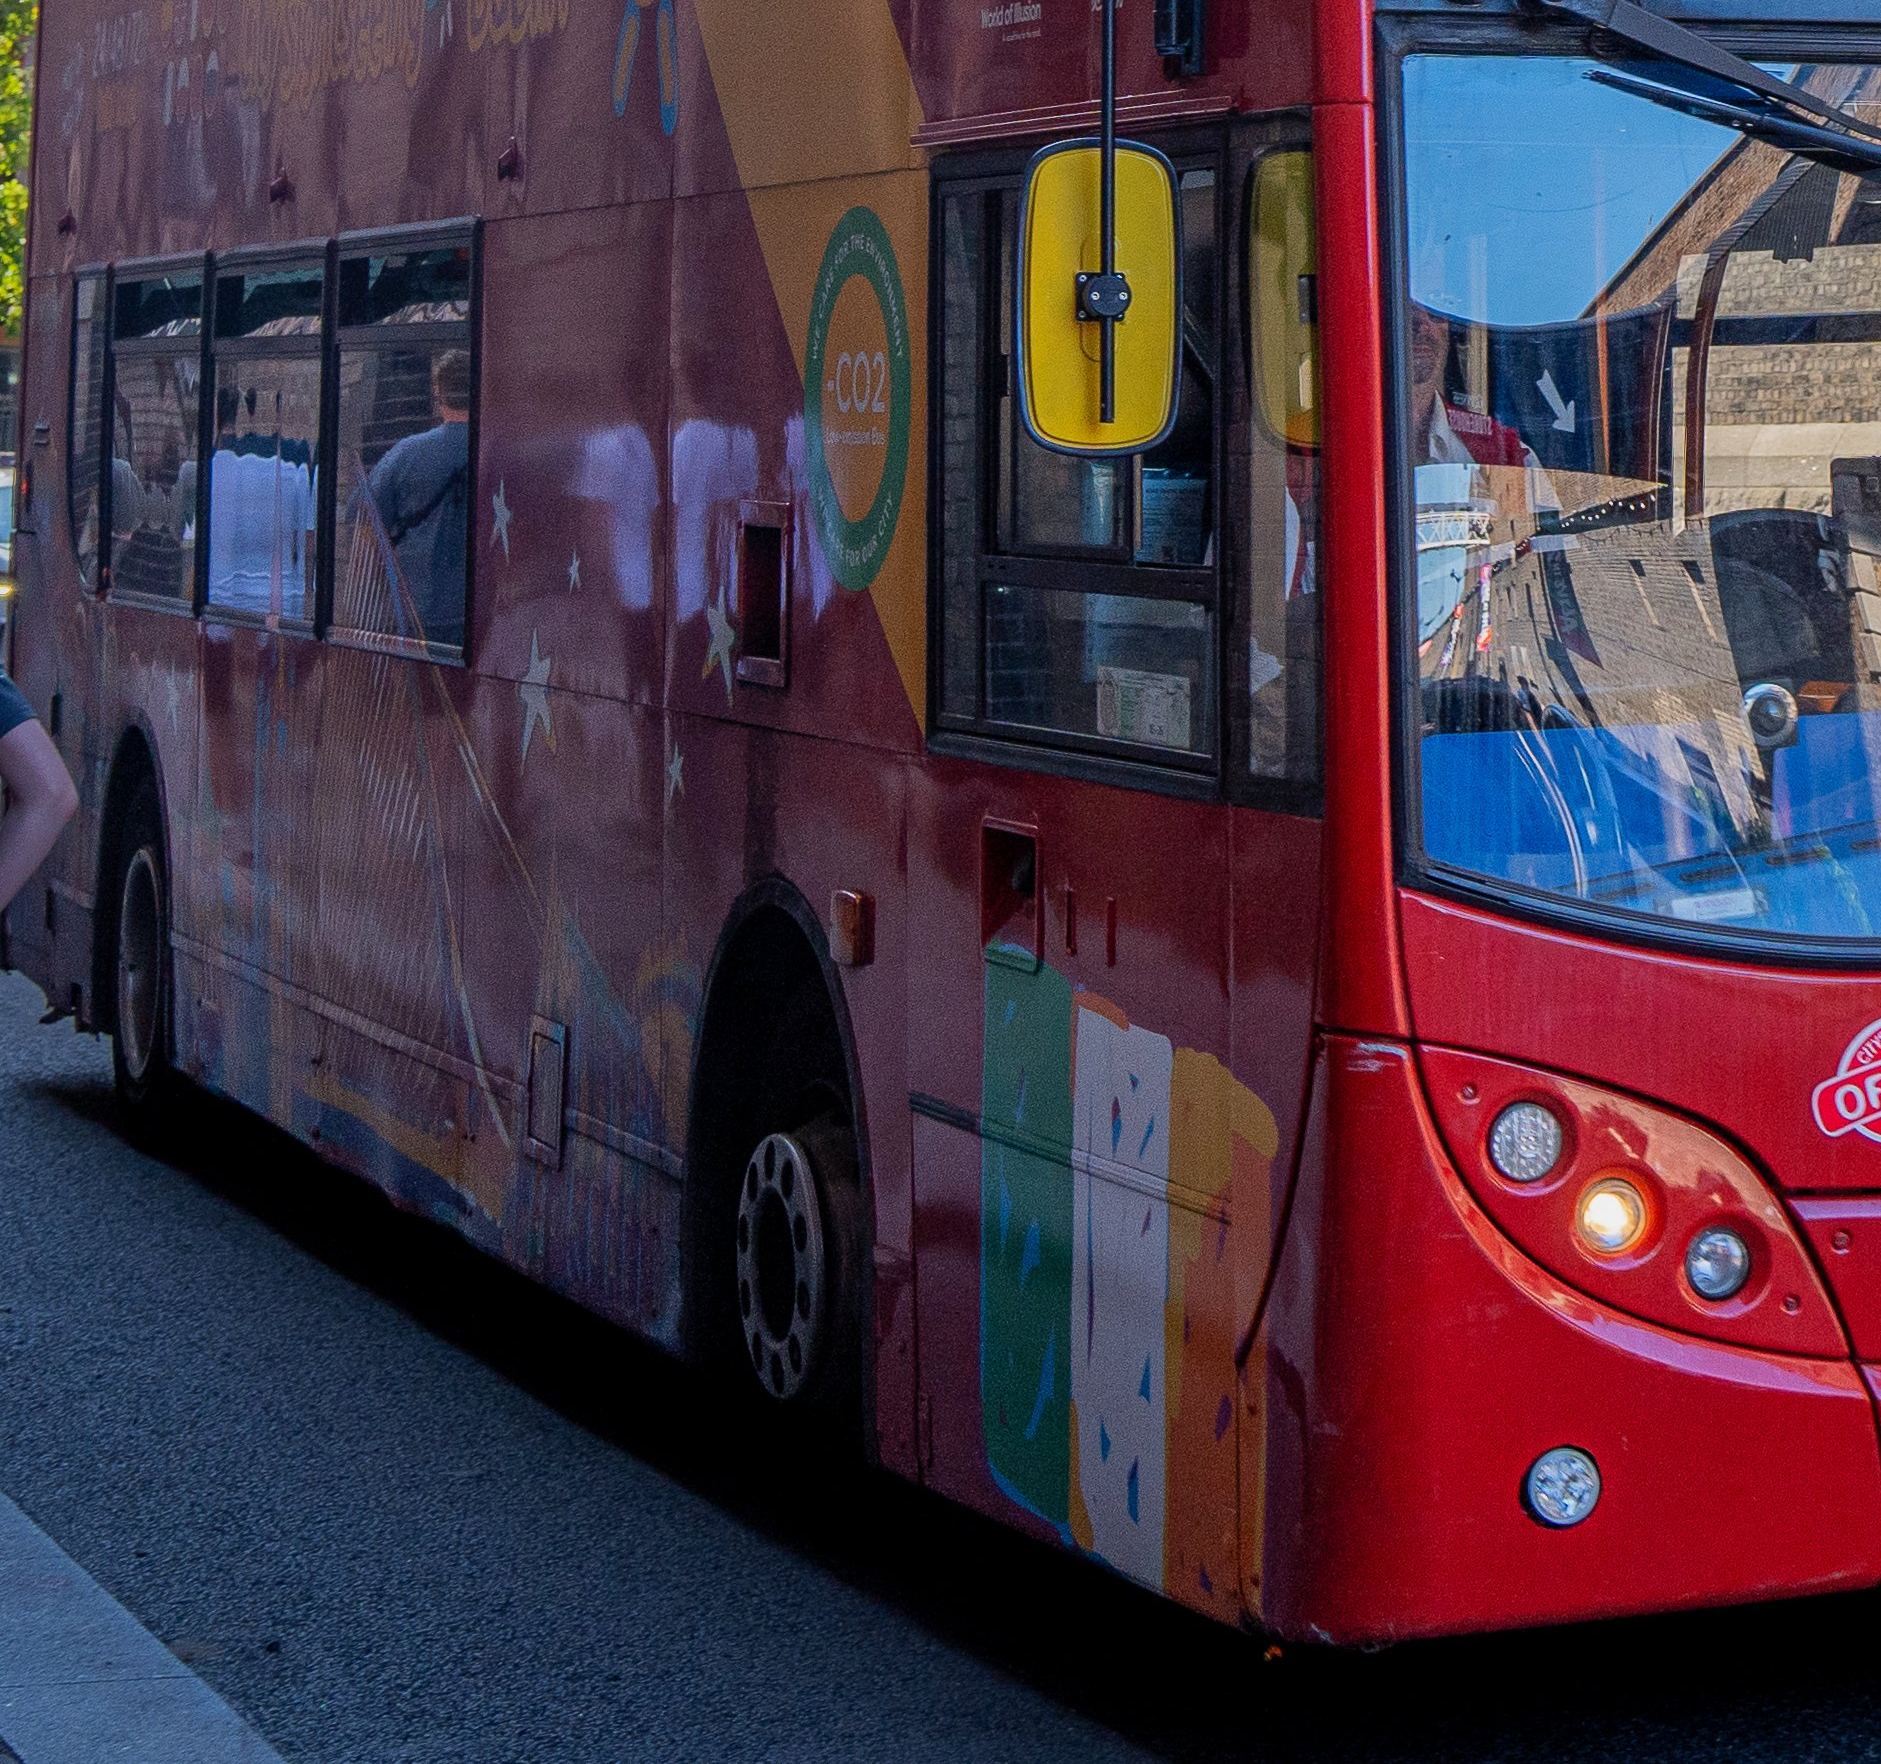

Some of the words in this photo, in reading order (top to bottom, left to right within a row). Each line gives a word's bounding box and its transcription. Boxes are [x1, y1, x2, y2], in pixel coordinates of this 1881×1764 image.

[980, 7, 1003, 30] World
[1012, 0, 1042, 25] Illusion
[850, 234, 865, 253] THE
[864, 236, 903, 358] ENVIRONMENT
[877, 492, 894, 533] CITY
